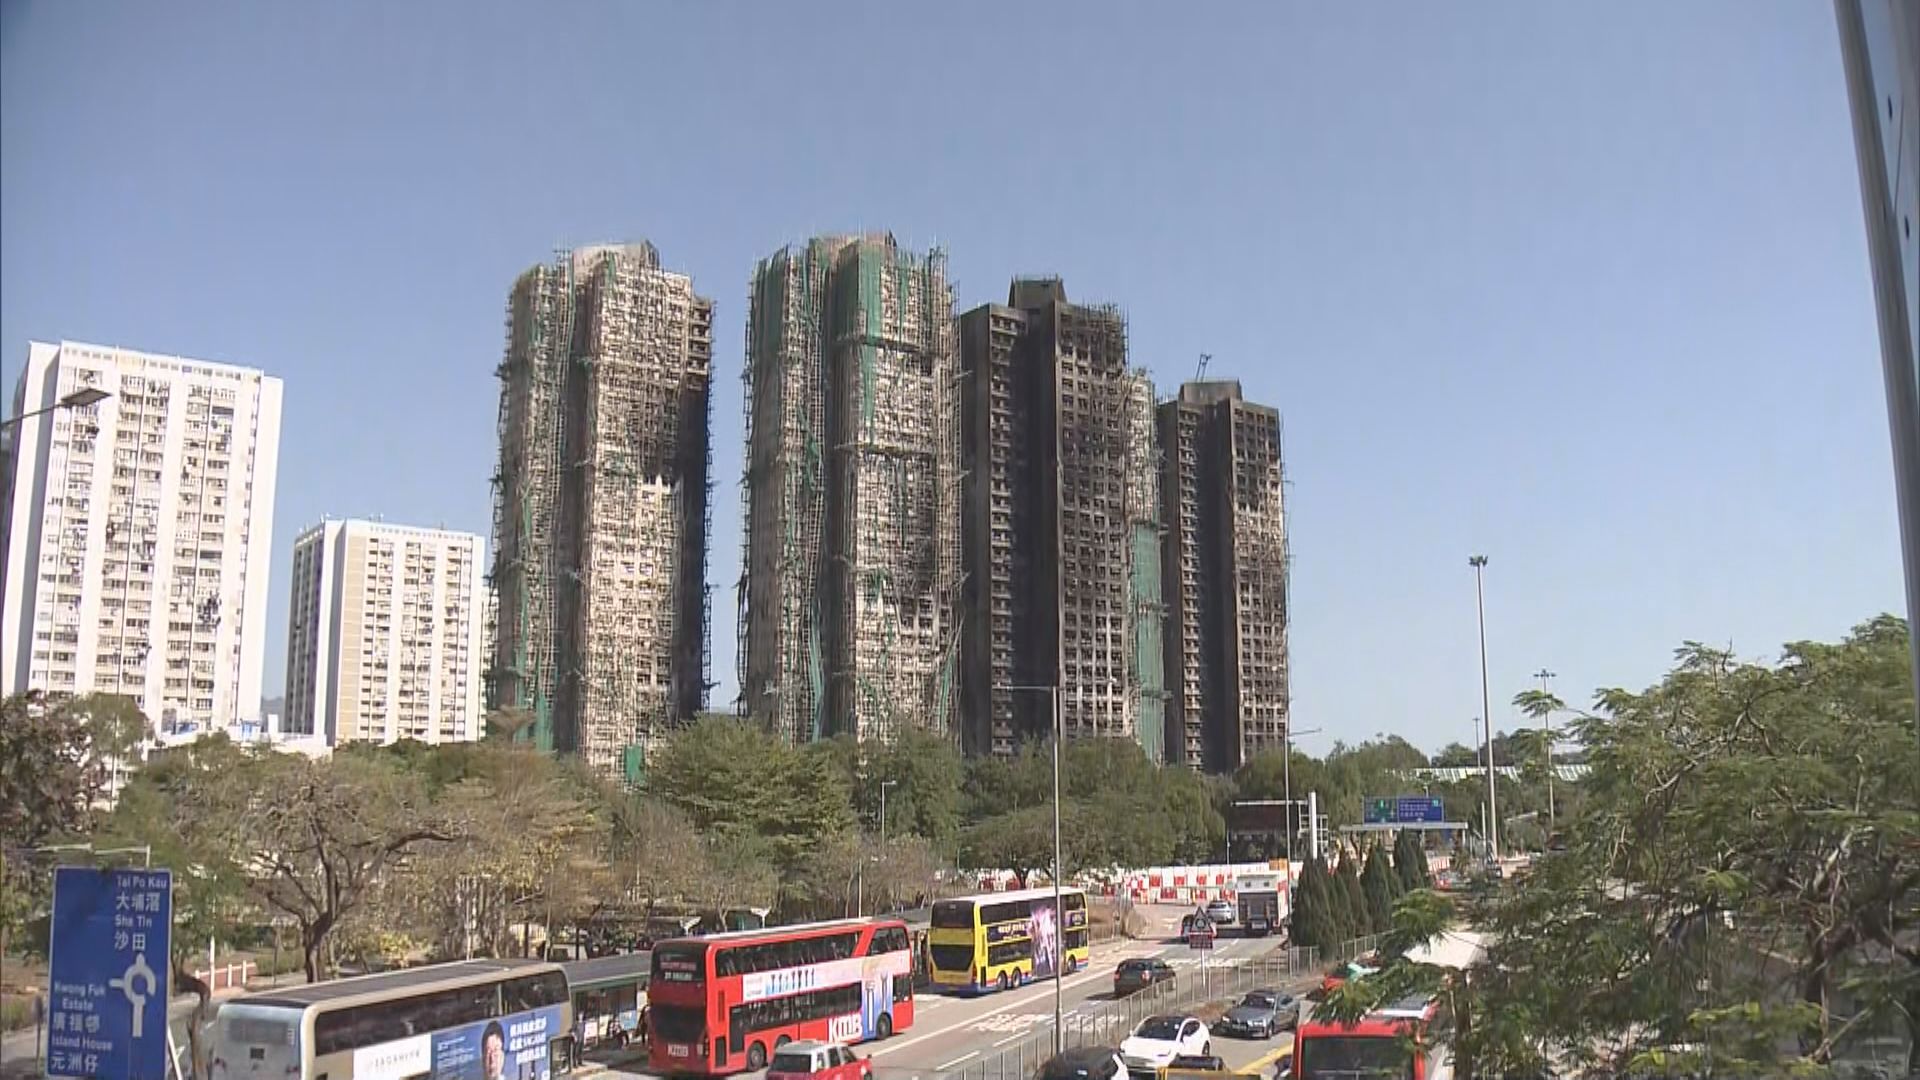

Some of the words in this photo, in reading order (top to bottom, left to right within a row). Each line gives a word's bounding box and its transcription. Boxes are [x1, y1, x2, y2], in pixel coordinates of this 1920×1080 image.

[117, 876, 130, 887] Tai
[133, 876, 145, 887] Po
[148, 876, 167, 889] Kau
[115, 914, 133, 928] Sha
[136, 916, 152, 928] Tin
[114, 931, 146, 951] 沙田
[54, 981, 85, 996] Kwong
[88, 984, 105, 996] Fuk
[62, 998, 94, 1011] Estate
[52, 1035, 80, 1048] Island
[82, 1037, 113, 1051] House
